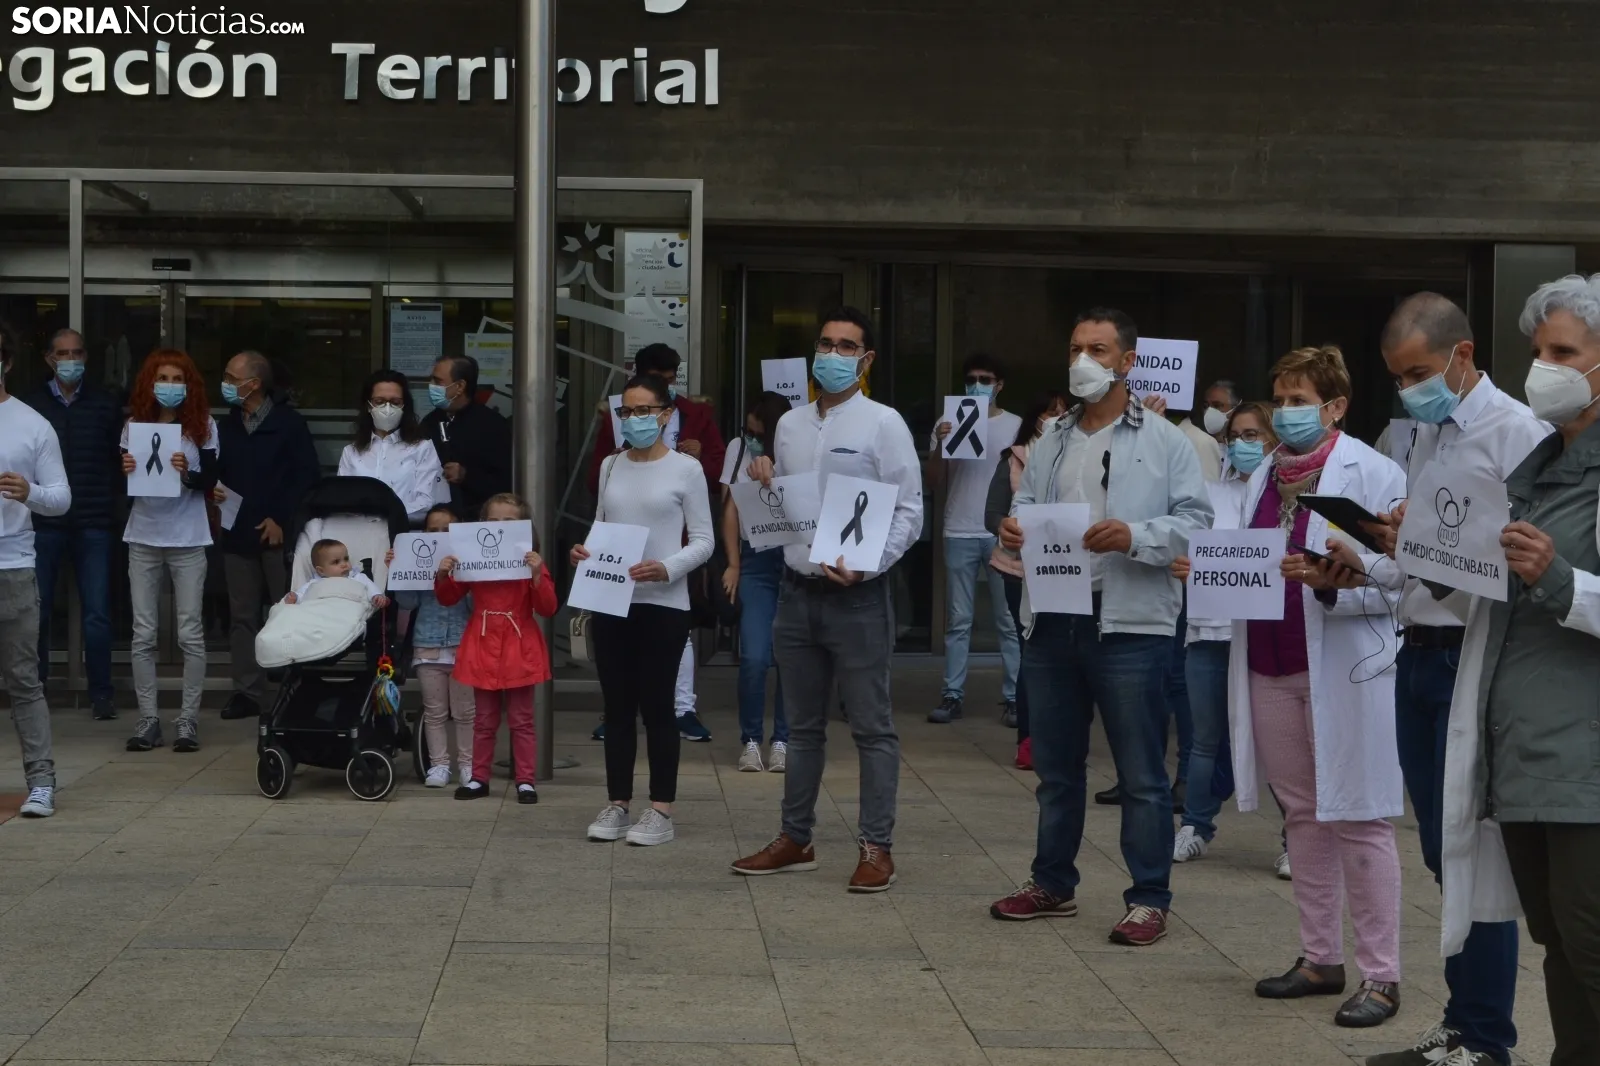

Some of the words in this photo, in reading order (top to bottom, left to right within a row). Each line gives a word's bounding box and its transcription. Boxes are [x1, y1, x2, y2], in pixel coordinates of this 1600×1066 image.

[0, 38, 278, 111] gación
[331, 42, 719, 106] Terriorial
[1131, 355, 1183, 371] NIDAD
[1125, 379, 1181, 394] RIORIDAD
[1043, 544, 1071, 554] S.O.S
[1195, 545, 1270, 559] PRECARIEDAD
[456, 559, 527, 571] #SANIDADENLUCHA
[598, 553, 623, 564] S.O.S
[1402, 540, 1500, 580] #MEDICOSDICENBASTA
[391, 570, 438, 581] #BATASBLA
[584, 569, 626, 583] SANIDAD
[1035, 565, 1082, 576] SANIDAD
[1193, 570, 1271, 588] PERSONAL
